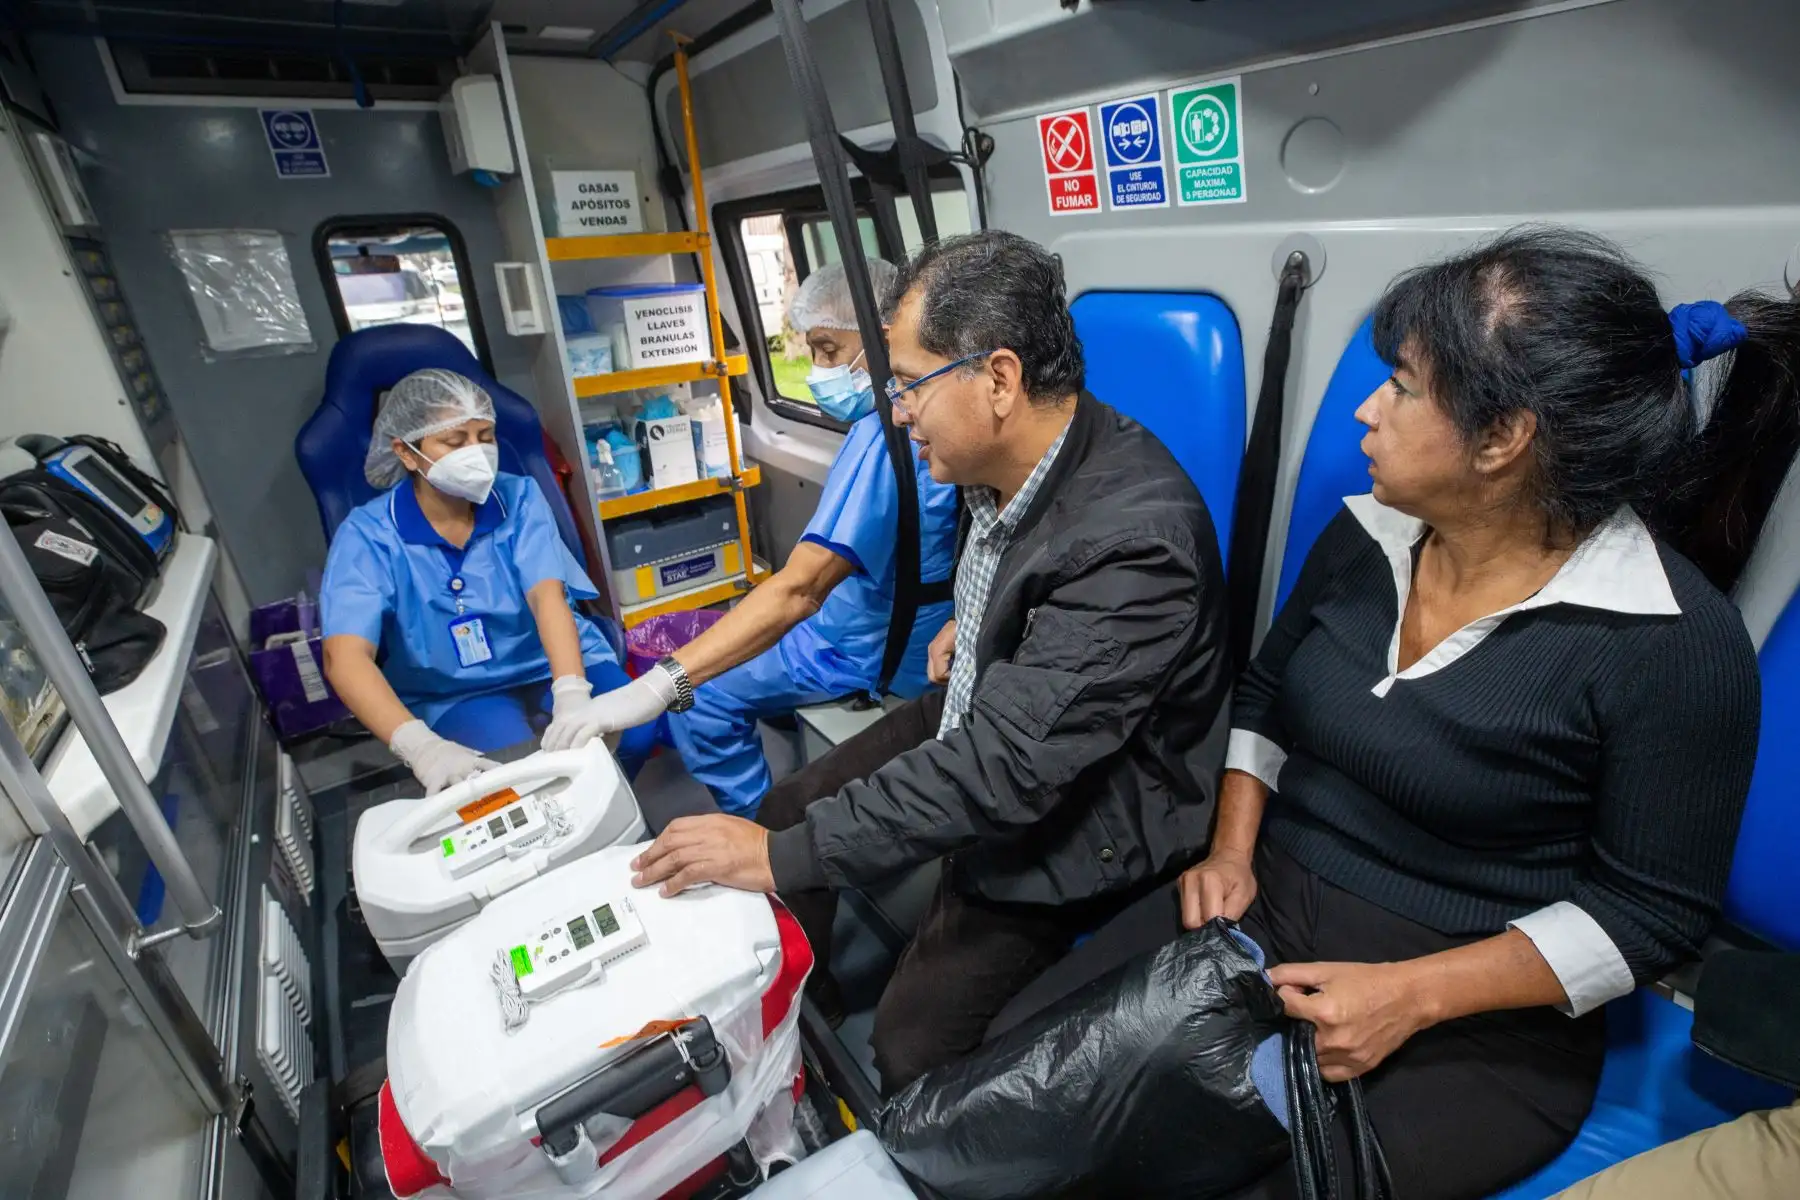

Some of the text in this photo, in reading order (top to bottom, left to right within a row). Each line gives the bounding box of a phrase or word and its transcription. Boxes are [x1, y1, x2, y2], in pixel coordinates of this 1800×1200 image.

[1129, 171, 1142, 181] USE
[1186, 166, 1233, 178] CAPACIDAD
[578, 183, 619, 194] GASAS
[1064, 179, 1080, 192] NO
[1117, 181, 1158, 193] EL CINTURON
[1194, 178, 1227, 188] MAXIMA
[1116, 192, 1162, 203] DE SEGURIDAD
[1192, 188, 1238, 199] PERSONAS
[571, 198, 631, 210] APÓSITOS
[1056, 194, 1093, 208] FUMAR
[579, 216, 628, 227] VENDAS
[635, 305, 693, 320] VENOCLISIS
[647, 319, 686, 331] LLAVES
[640, 331, 695, 345] BRANULAS
[641, 344, 698, 359] EXTENSIÓN
